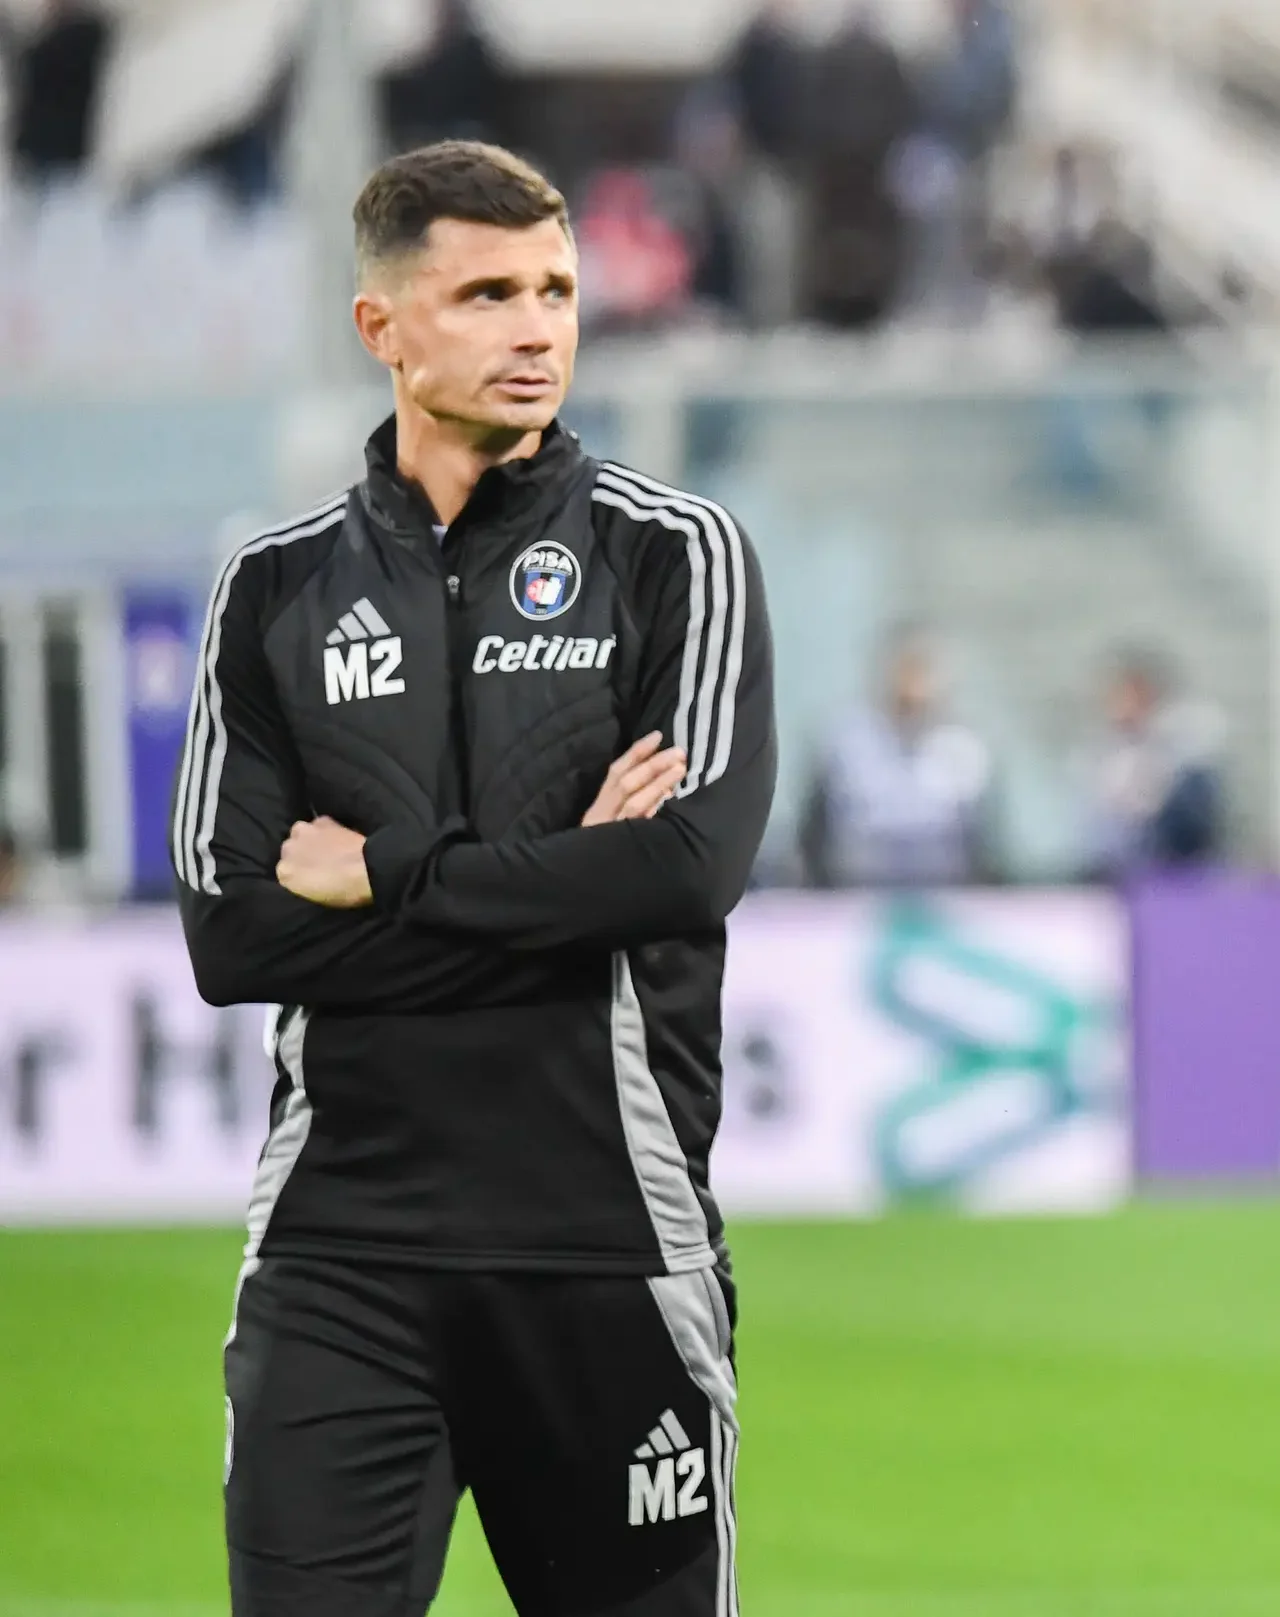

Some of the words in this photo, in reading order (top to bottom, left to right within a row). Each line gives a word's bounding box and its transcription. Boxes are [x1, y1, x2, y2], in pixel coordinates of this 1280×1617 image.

[522, 550, 573, 576] PISA
[323, 636, 406, 705] M2
[472, 634, 617, 674] Cetilar
[628, 1447, 708, 1526] M2
